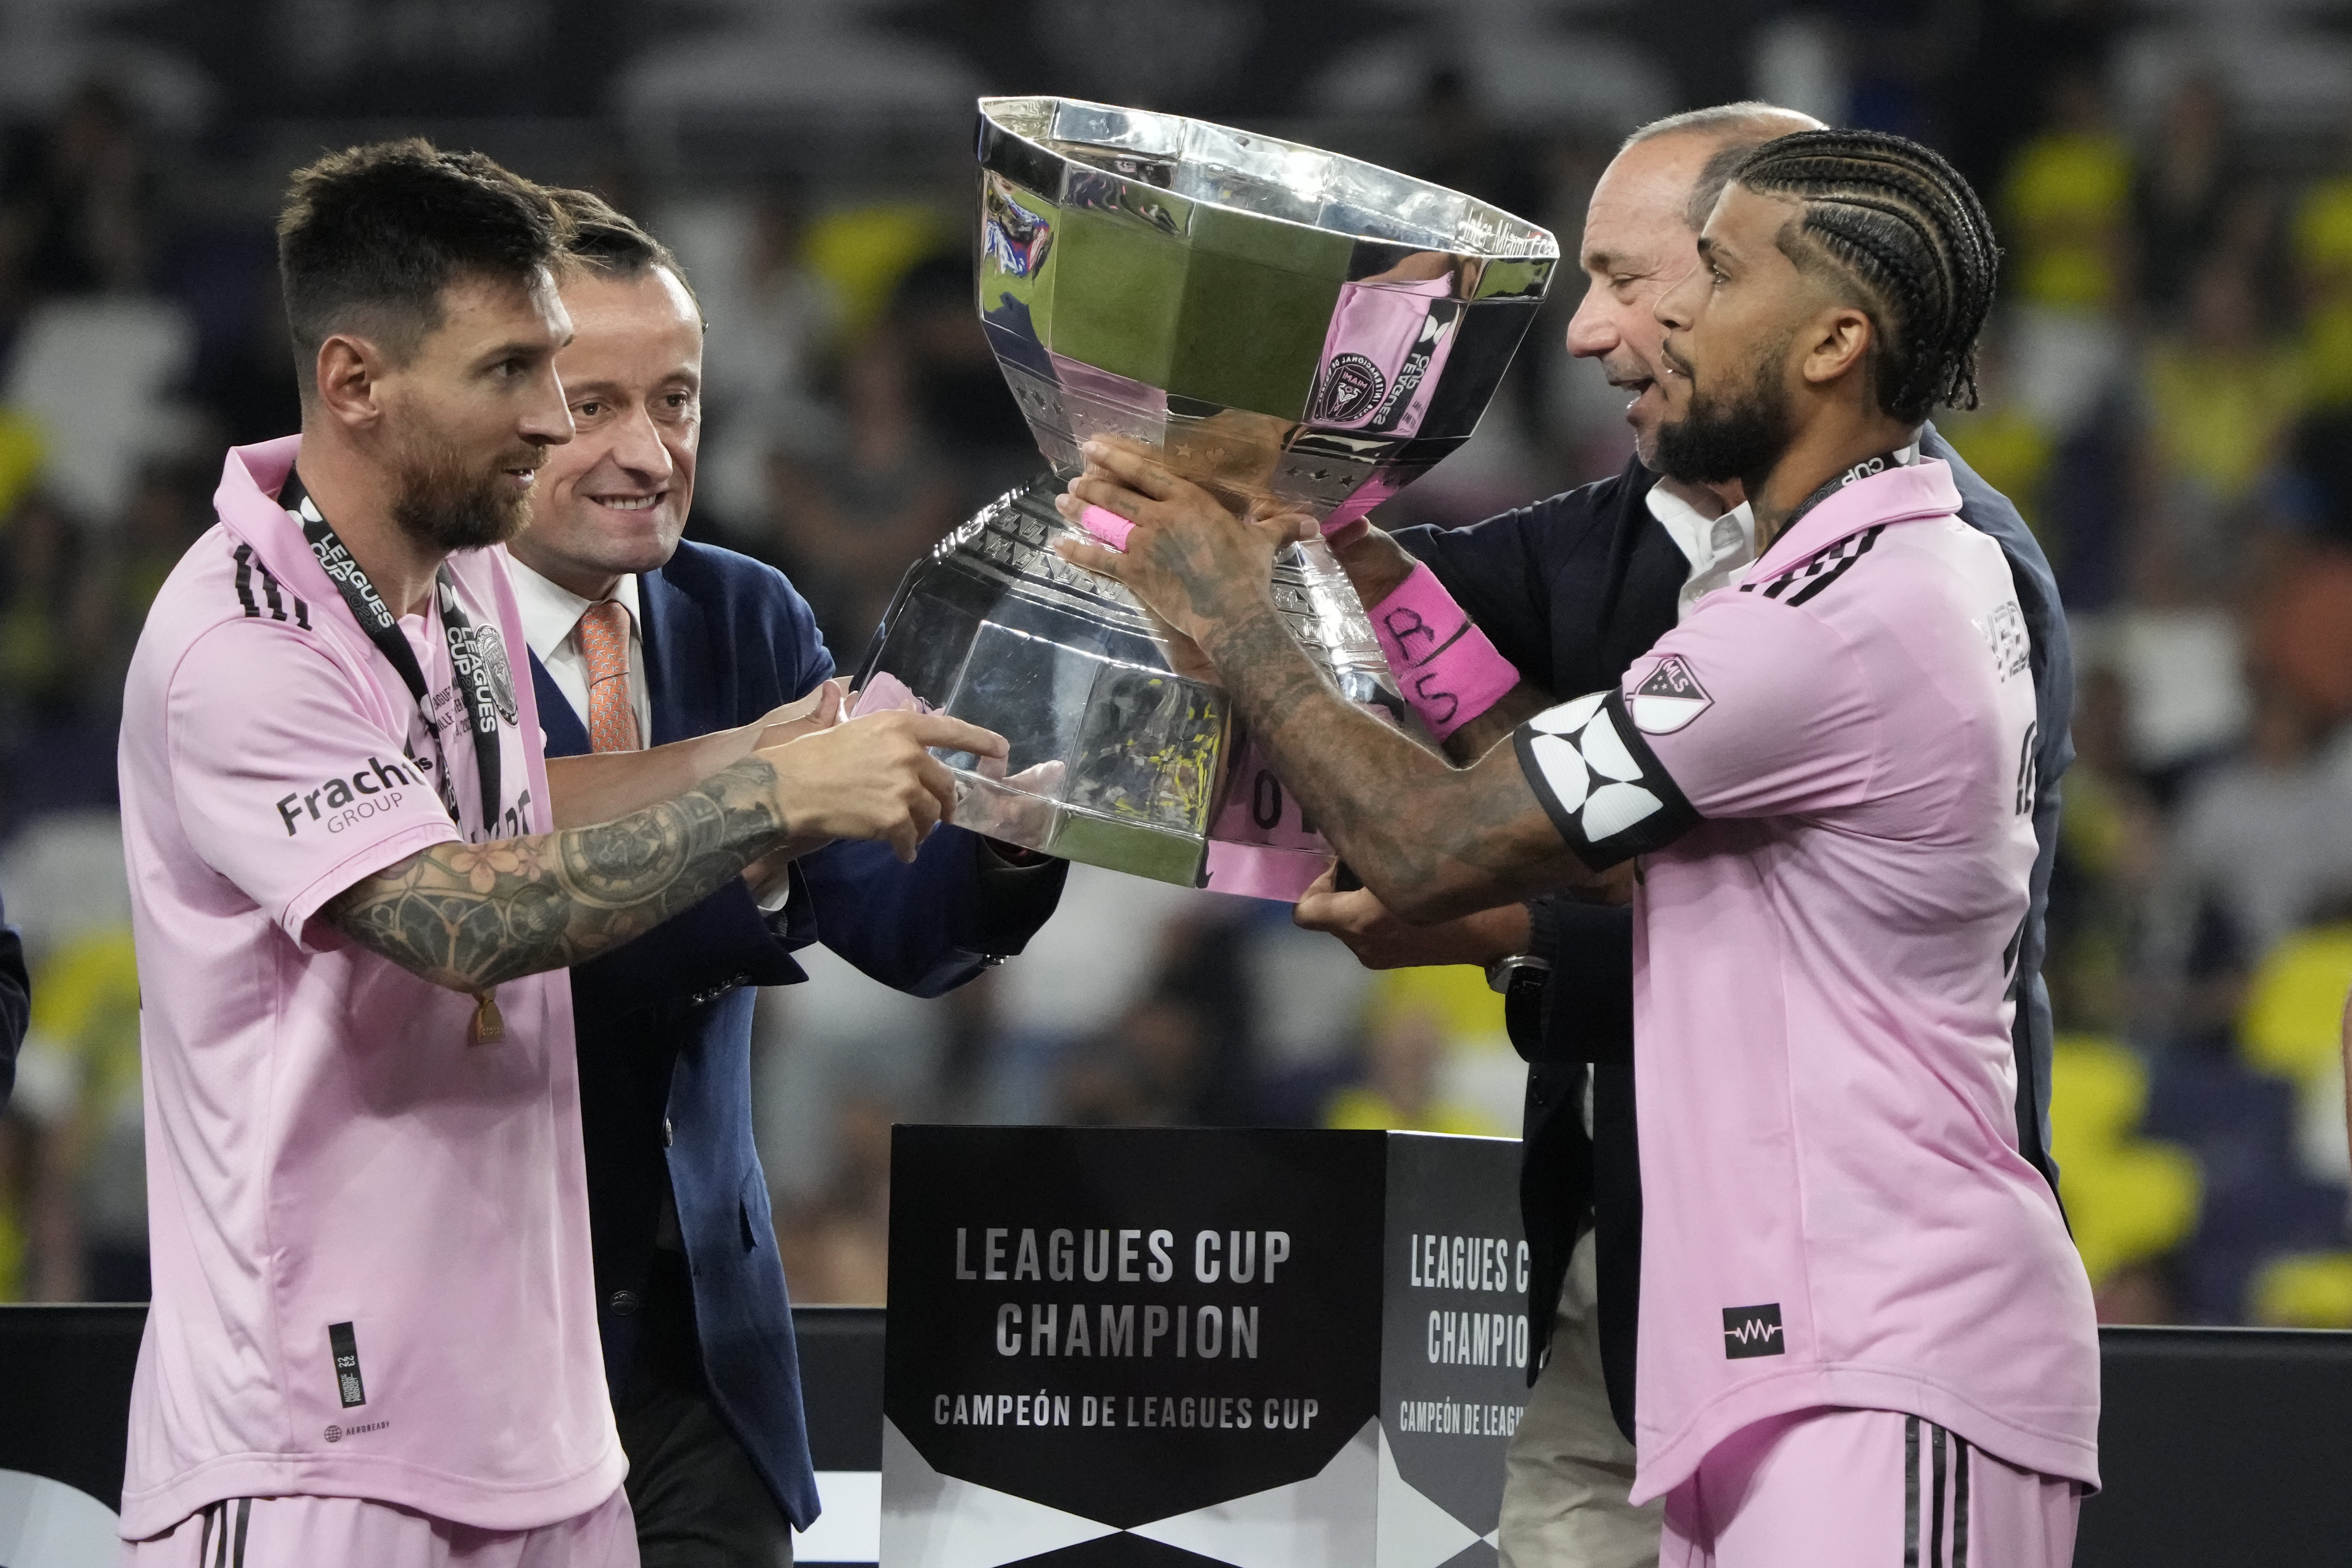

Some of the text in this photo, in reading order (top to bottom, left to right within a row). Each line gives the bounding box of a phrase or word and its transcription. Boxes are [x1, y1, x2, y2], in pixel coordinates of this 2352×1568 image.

[1841, 457, 1885, 486] CUP
[311, 542, 347, 582] CUP
[320, 532, 395, 628] LEAGUES
[447, 626, 471, 675] CUP
[461, 627, 496, 733] LEAGUES
[1663, 661, 1689, 693] MLS
[328, 792, 402, 833] GROUP
[955, 1227, 1290, 1284] LEAGUES CUP
[1411, 1234, 1529, 1293] LEAGUES C
[996, 1303, 1259, 1359] CHAMPION
[1428, 1310, 1529, 1368] CHAMPIO
[337, 1357, 347, 1368] 22
[345, 1355, 355, 1366] 23
[341, 1374, 351, 1402] AUTHENTIC
[347, 1377, 356, 1402] LICENSED
[353, 1378, 361, 1401] PRODUCT
[346, 1421, 390, 1435] AEROREADY
[934, 1389, 1319, 1430] CAMPEÓN DE LEAGUES CUP
[1400, 1396, 1460, 1434] CAMPEÓN
[1464, 1403, 1480, 1435] DE
